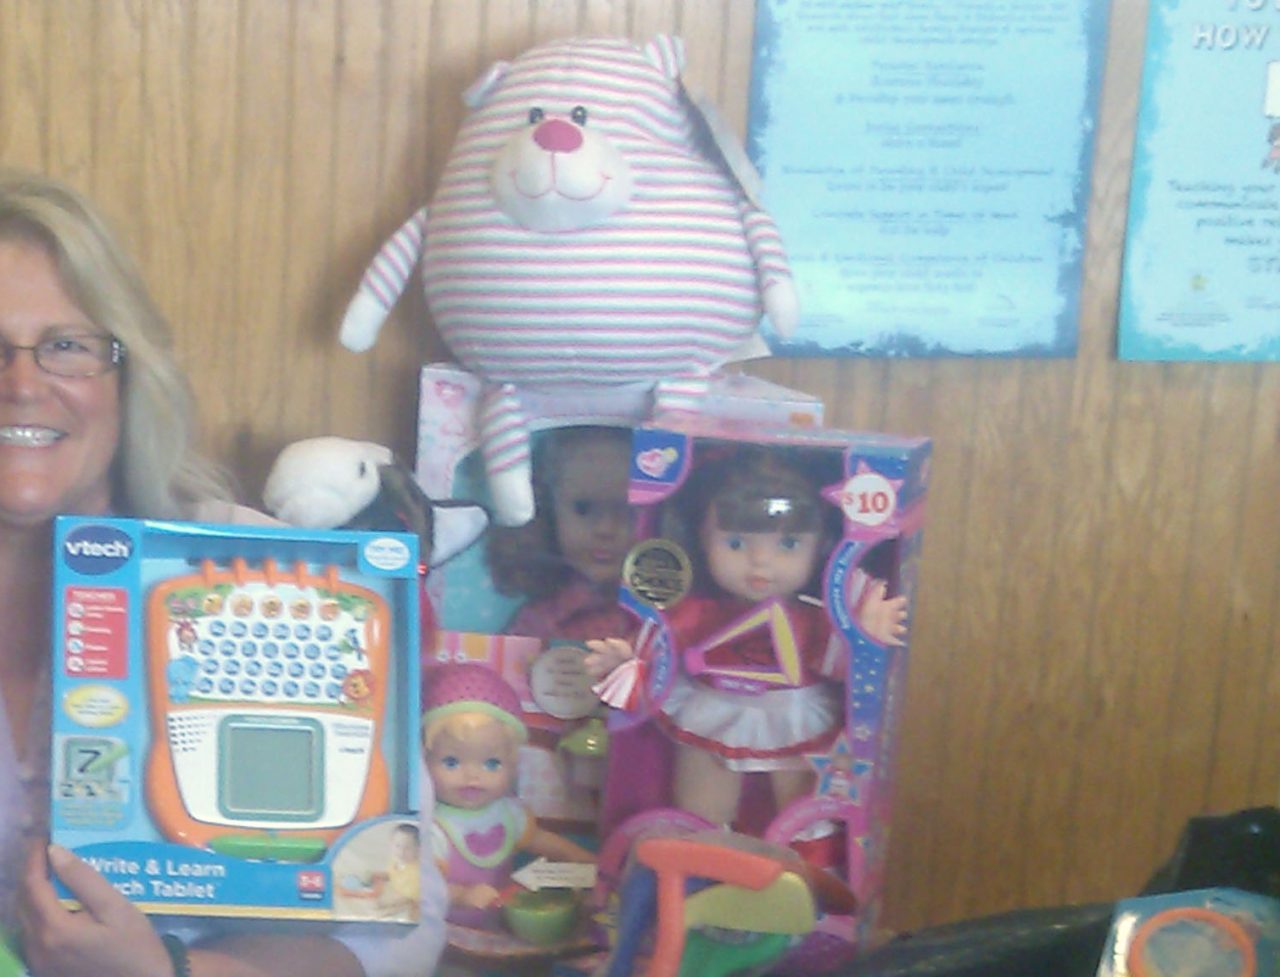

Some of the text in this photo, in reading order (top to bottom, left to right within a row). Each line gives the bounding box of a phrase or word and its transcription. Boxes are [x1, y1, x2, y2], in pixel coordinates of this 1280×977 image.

[1191, 22, 1269, 51] HOW
[65, 540, 129, 557] vtech
[144, 858, 162, 876] &
[166, 859, 227, 877] Learn
[150, 879, 216, 898] Tablet
